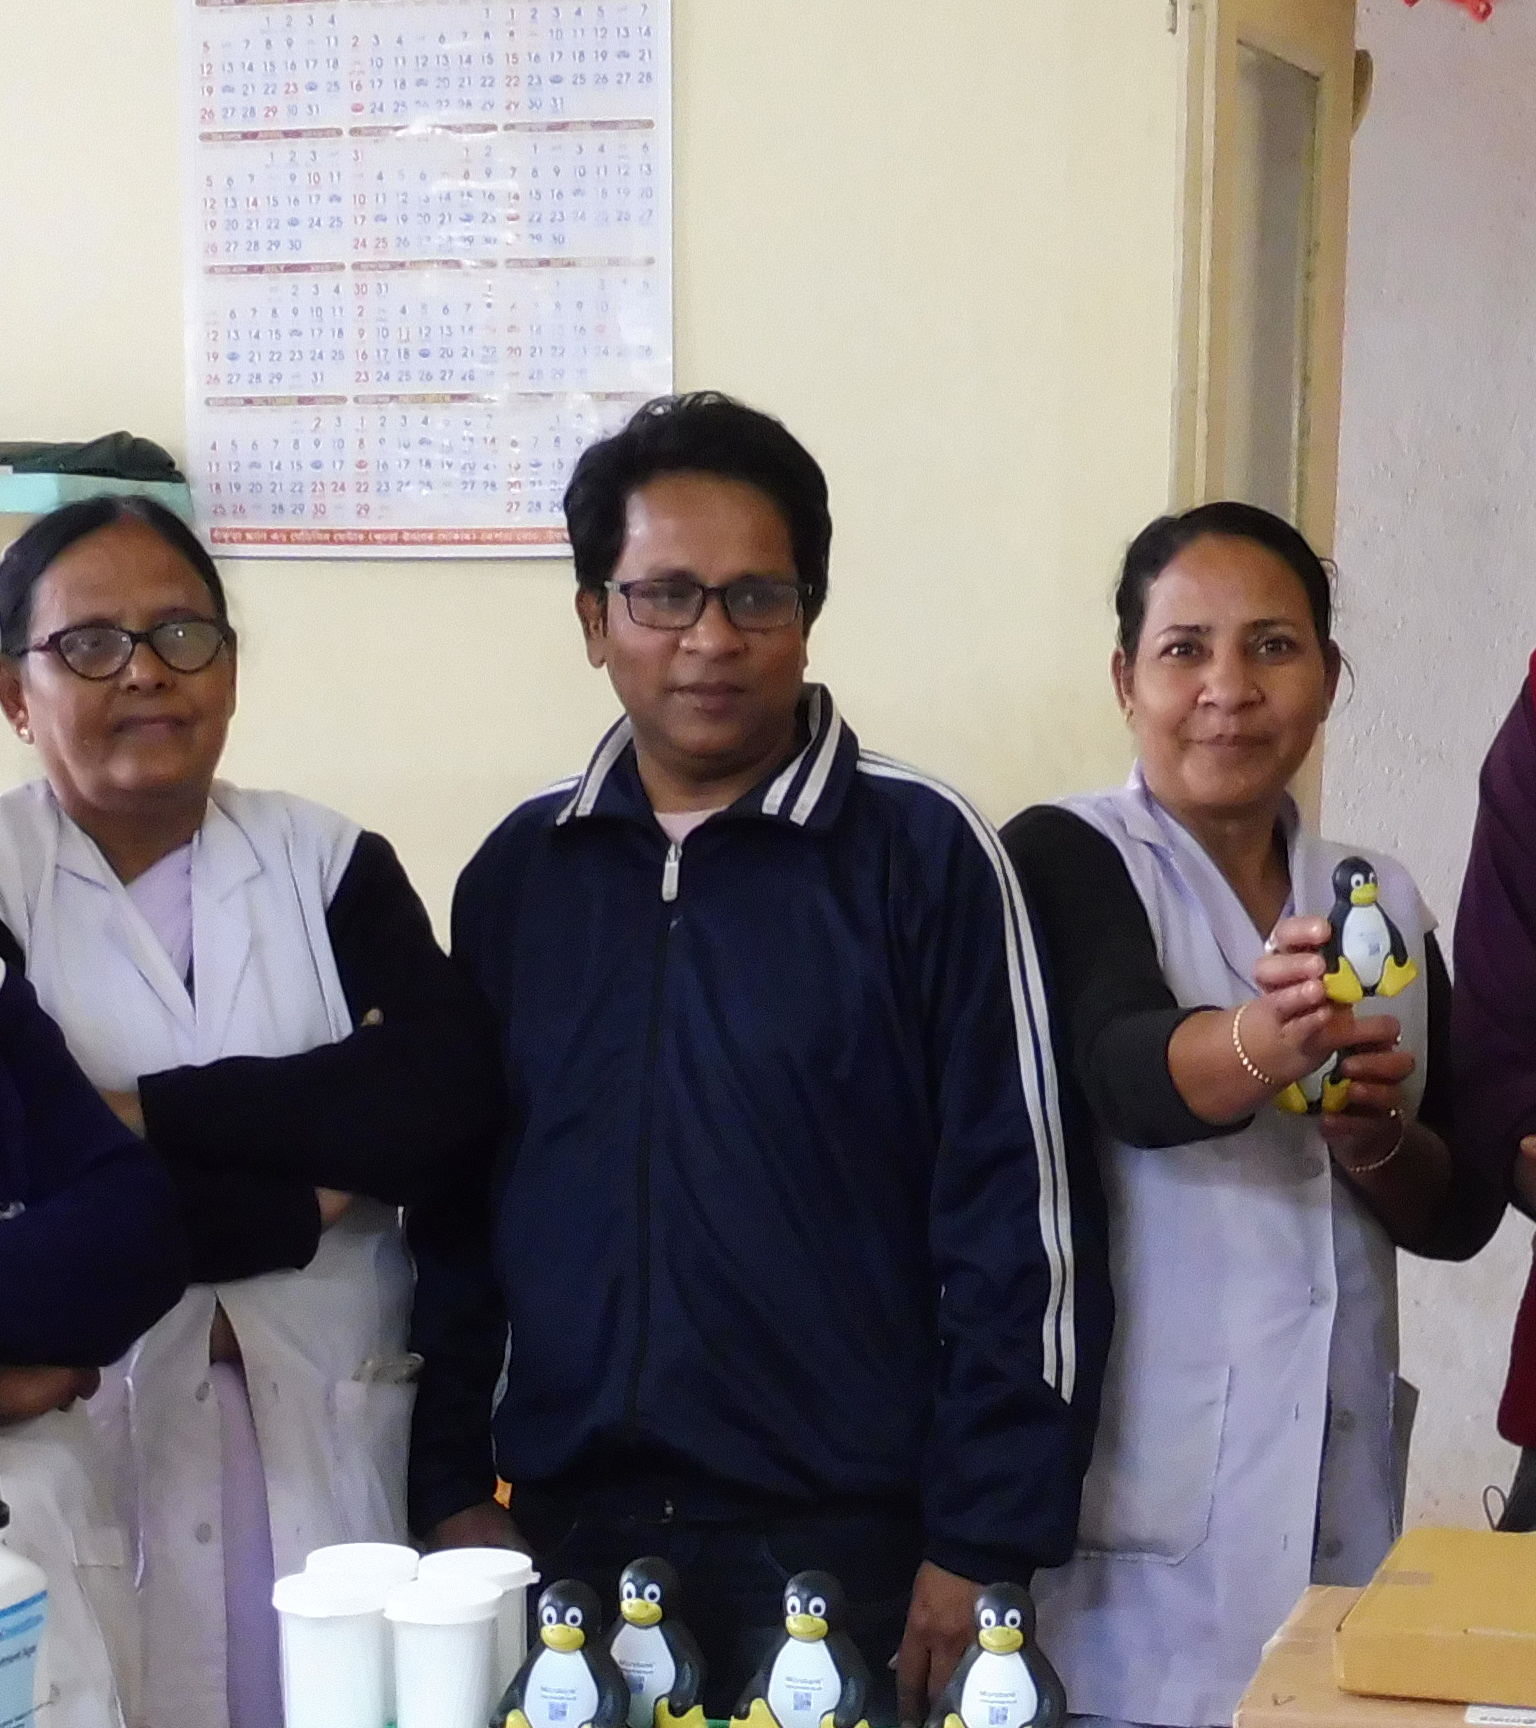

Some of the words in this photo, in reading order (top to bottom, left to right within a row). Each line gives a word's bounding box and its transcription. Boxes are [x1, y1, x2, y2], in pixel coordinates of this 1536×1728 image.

[617, 27, 629, 38] 13
[639, 26, 651, 37] 14
[326, 36, 338, 47] 11
[506, 53, 519, 65] 15
[528, 52, 541, 63] 16
[573, 50, 585, 62] 18
[595, 50, 608, 61] 19
[639, 49, 652, 61] 21
[200, 62, 213, 76] 12
[222, 62, 234, 73] 13
[242, 62, 253, 72] 14
[263, 61, 276, 74] 15
[285, 60, 296, 71] 16
[305, 59, 318, 69] 17
[326, 58, 339, 70] 18
[506, 75, 520, 87] 22
[528, 74, 542, 86] 23
[572, 73, 586, 85] 25
[595, 74, 608, 84] 26
[616, 72, 631, 85] 27
[638, 72, 652, 83] 28
[202, 86, 213, 96] 19
[242, 84, 255, 97] 21
[264, 83, 277, 95] 22
[284, 82, 298, 95] 23
[327, 81, 340, 92] 25
[201, 108, 214, 123] 26
[222, 107, 236, 119] 27
[242, 106, 256, 118] 28
[264, 106, 278, 118] 29
[308, 104, 319, 116] 31
[203, 198, 216, 210] 12
[225, 197, 237, 209] 13
[246, 197, 258, 207] 14
[266, 196, 279, 207] 15
[287, 196, 299, 206] 16
[308, 194, 321, 204] 17
[269, 350, 282, 362] 22
[289, 350, 303, 362] 23
[311, 350, 323, 361] 24
[331, 349, 345, 361] 25
